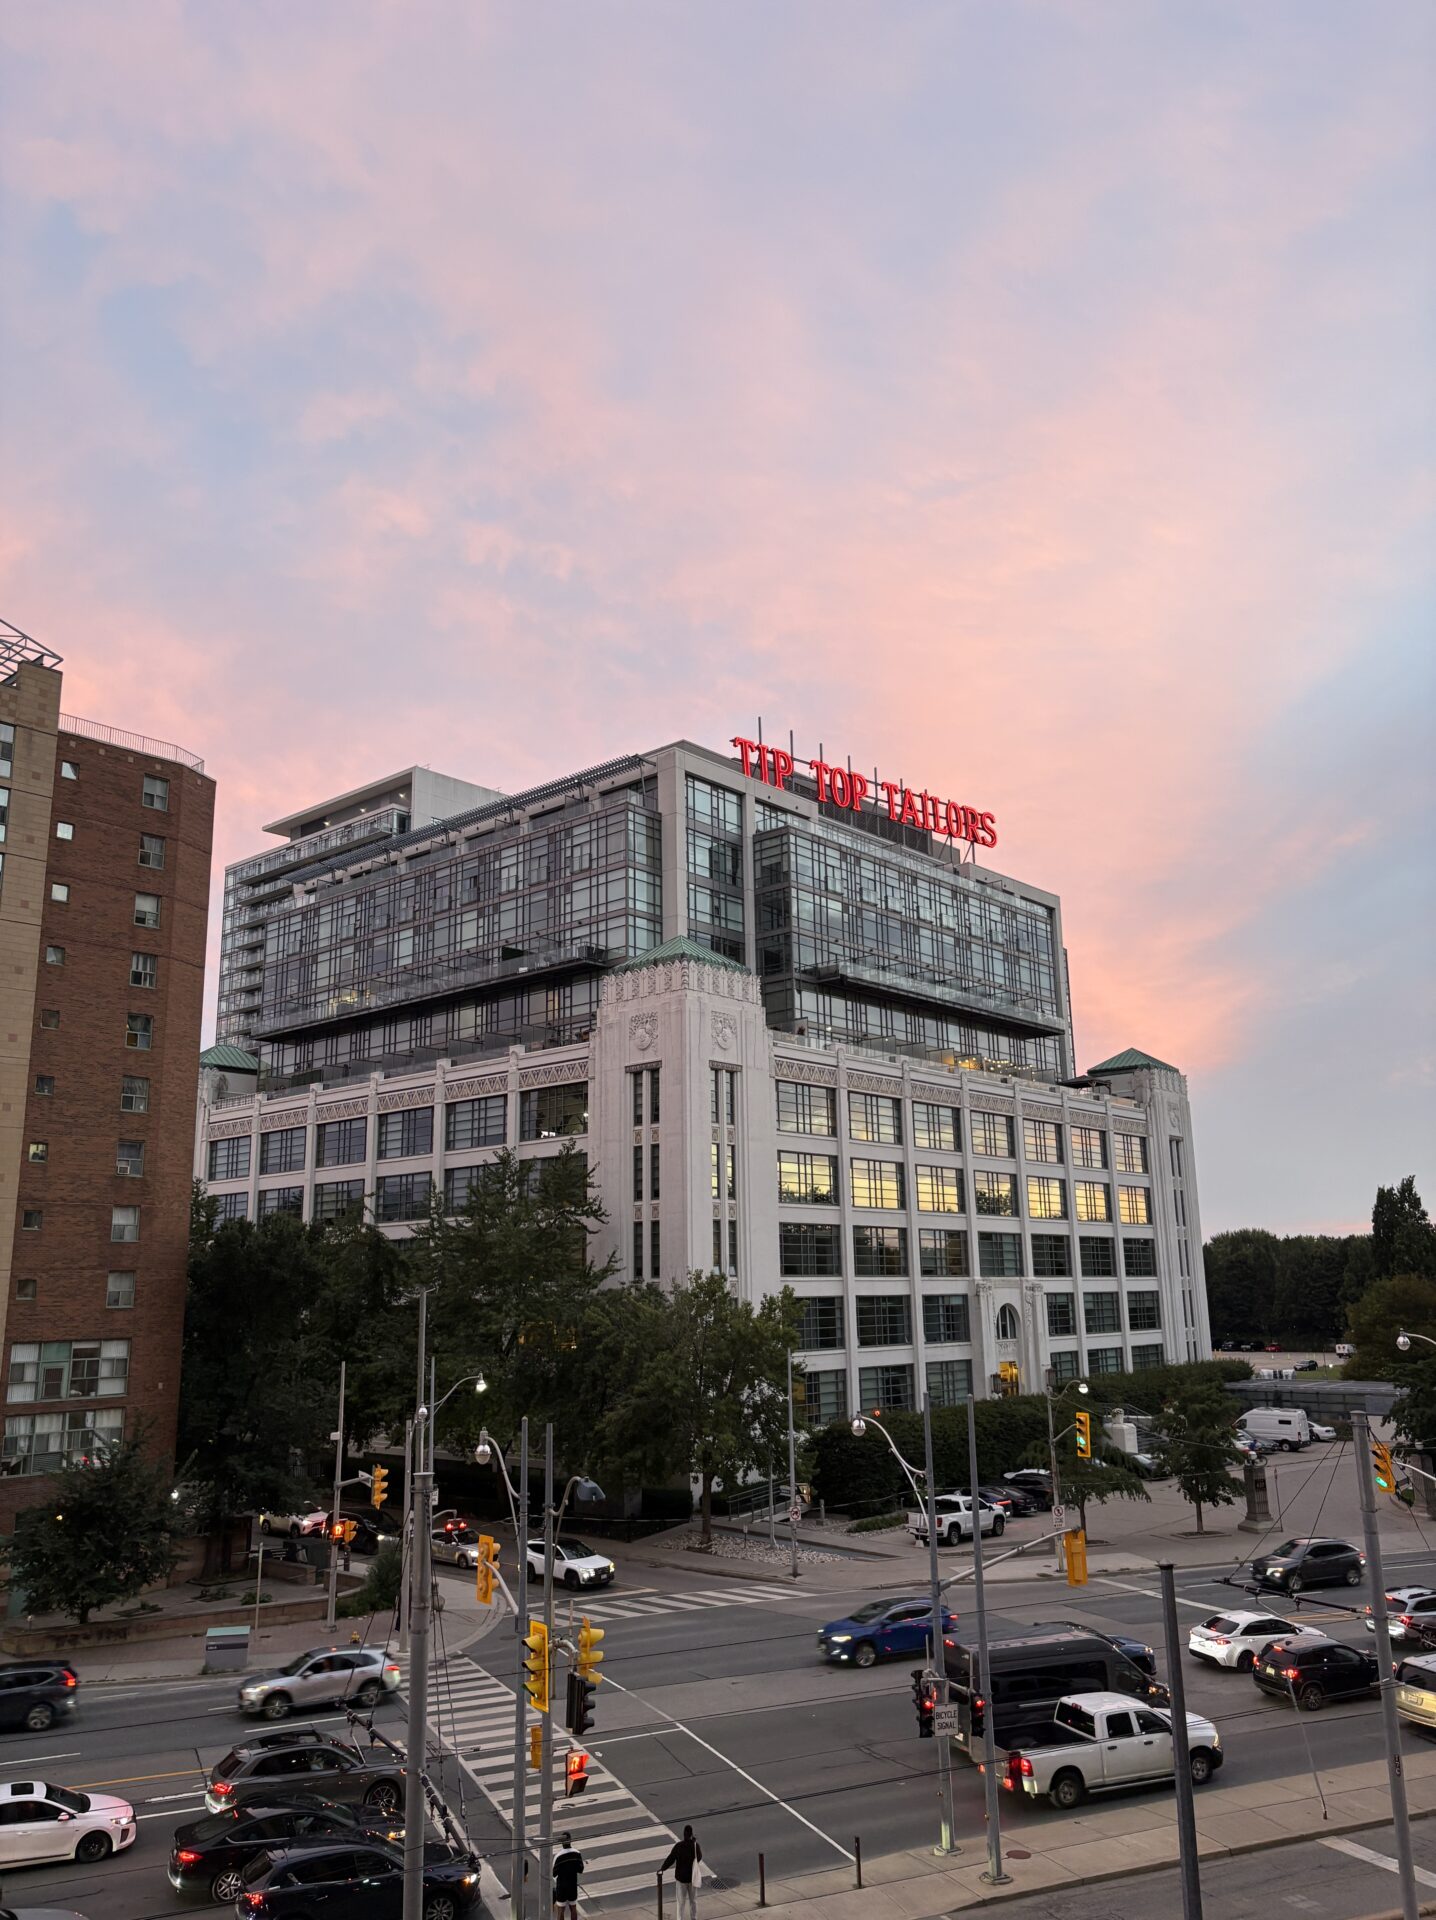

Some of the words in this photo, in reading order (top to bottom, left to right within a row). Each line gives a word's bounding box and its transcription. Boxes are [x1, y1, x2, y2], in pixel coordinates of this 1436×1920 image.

[732, 736, 794, 791] TIP
[810, 760, 868, 812] TOP
[881, 782, 997, 848] TAILORS
[935, 1710, 957, 1720] BICYCLE
[937, 1721, 956, 1730] SIGNAL
